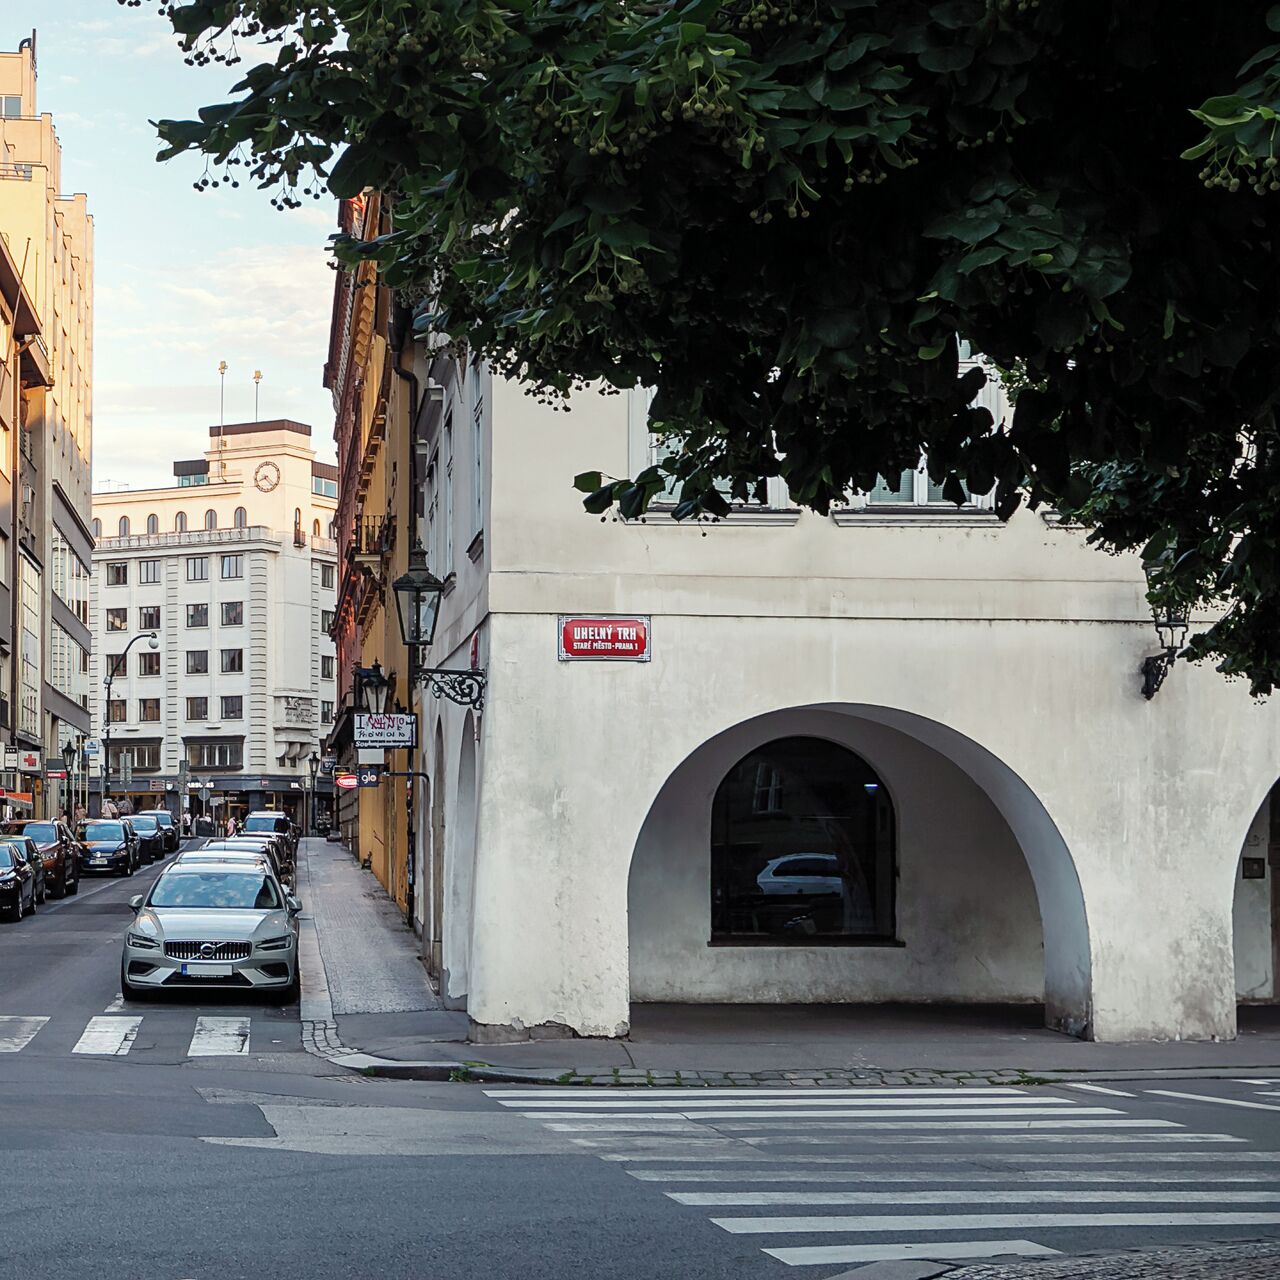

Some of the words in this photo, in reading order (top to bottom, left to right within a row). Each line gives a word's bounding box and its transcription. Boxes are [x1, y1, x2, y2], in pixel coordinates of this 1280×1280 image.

[573, 624, 612, 640] UHELNÝ
[617, 627, 636, 640] TRH
[573, 640, 591, 649] STARÉ
[361, 771, 377, 784] glo
